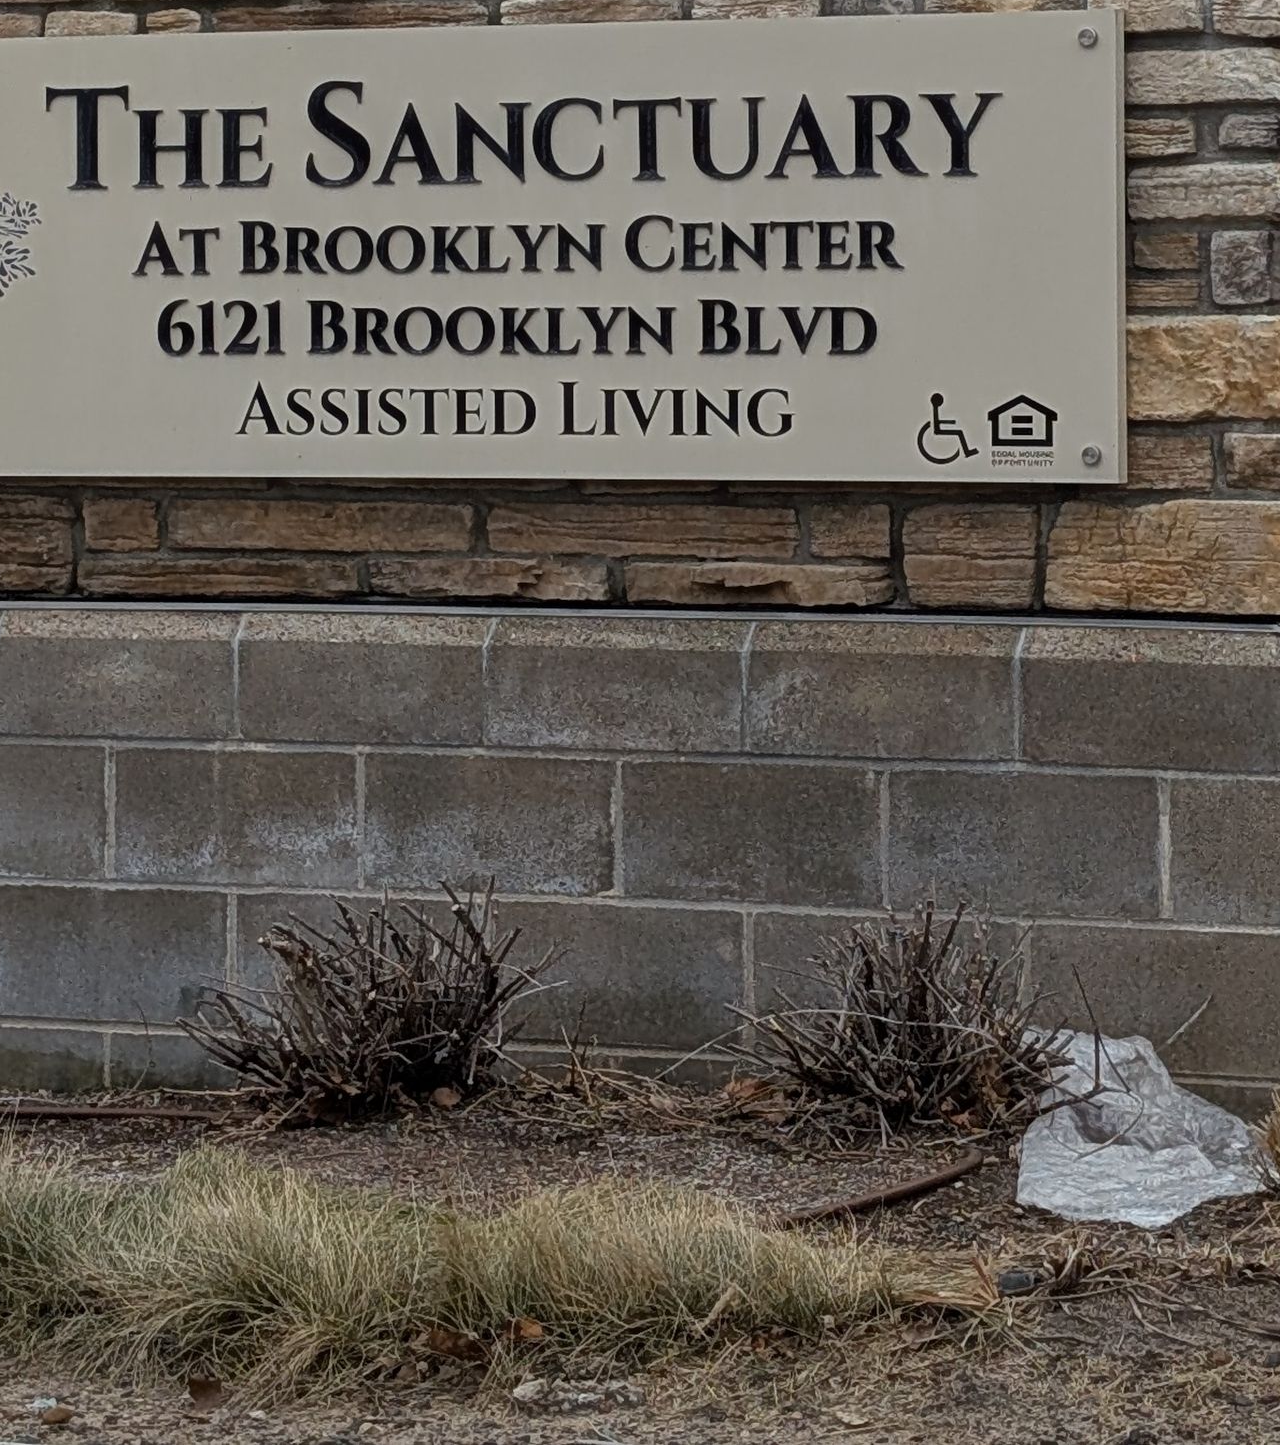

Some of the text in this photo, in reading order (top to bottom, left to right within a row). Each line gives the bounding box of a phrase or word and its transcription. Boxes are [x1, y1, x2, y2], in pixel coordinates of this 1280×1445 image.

[46, 80, 1003, 191] THE SANCTUARY
[131, 214, 905, 277] AT BROOKLYN CENTER
[157, 298, 878, 358] 6121 BROOKLYN BLVD
[235, 381, 795, 437] ASSISTED LIVING
